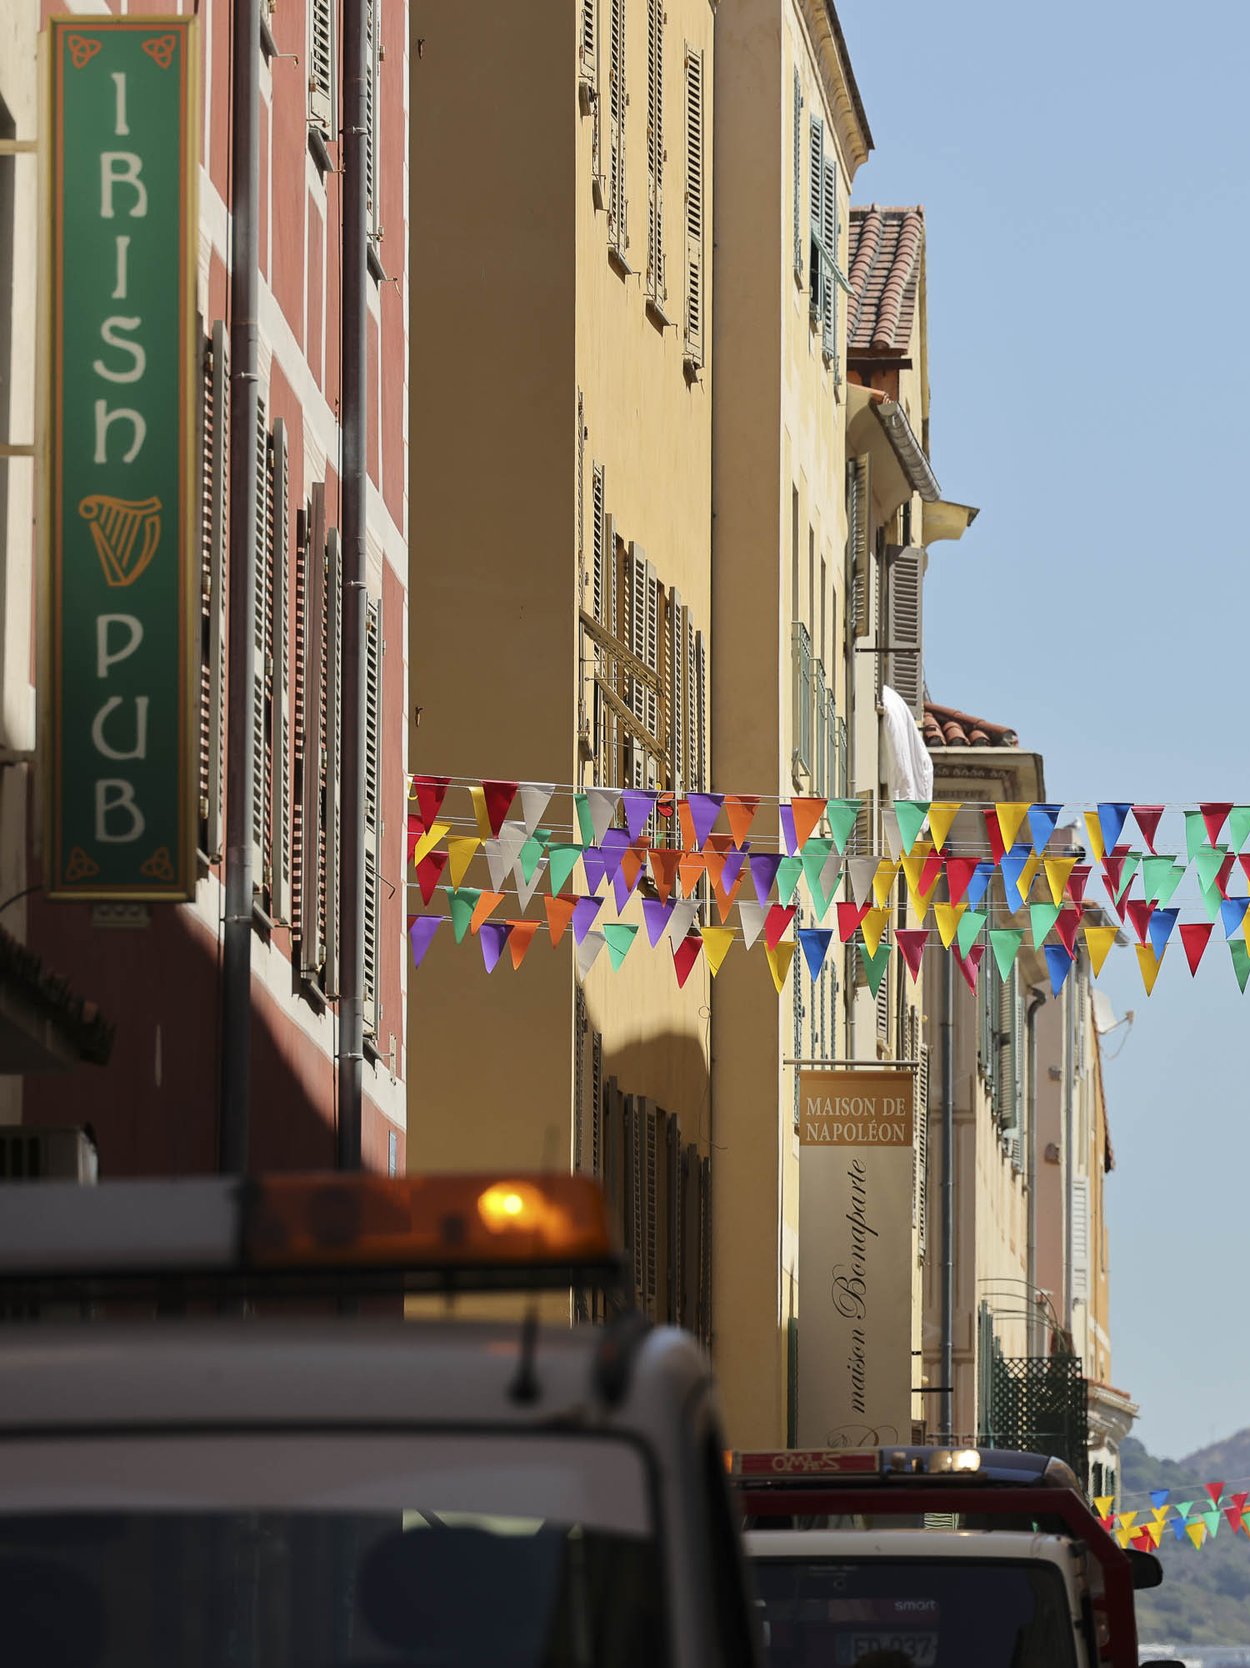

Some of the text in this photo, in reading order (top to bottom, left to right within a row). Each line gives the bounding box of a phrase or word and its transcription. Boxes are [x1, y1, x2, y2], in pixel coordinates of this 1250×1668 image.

[91, 613, 149, 843] PUB
[805, 1097, 906, 1116] MAISON DE
[805, 1119, 906, 1142] NAPOLÉON
[831, 1159, 879, 1320] Bonaparte
[847, 1329, 866, 1413] maison
[894, 1599, 937, 1612] smart
